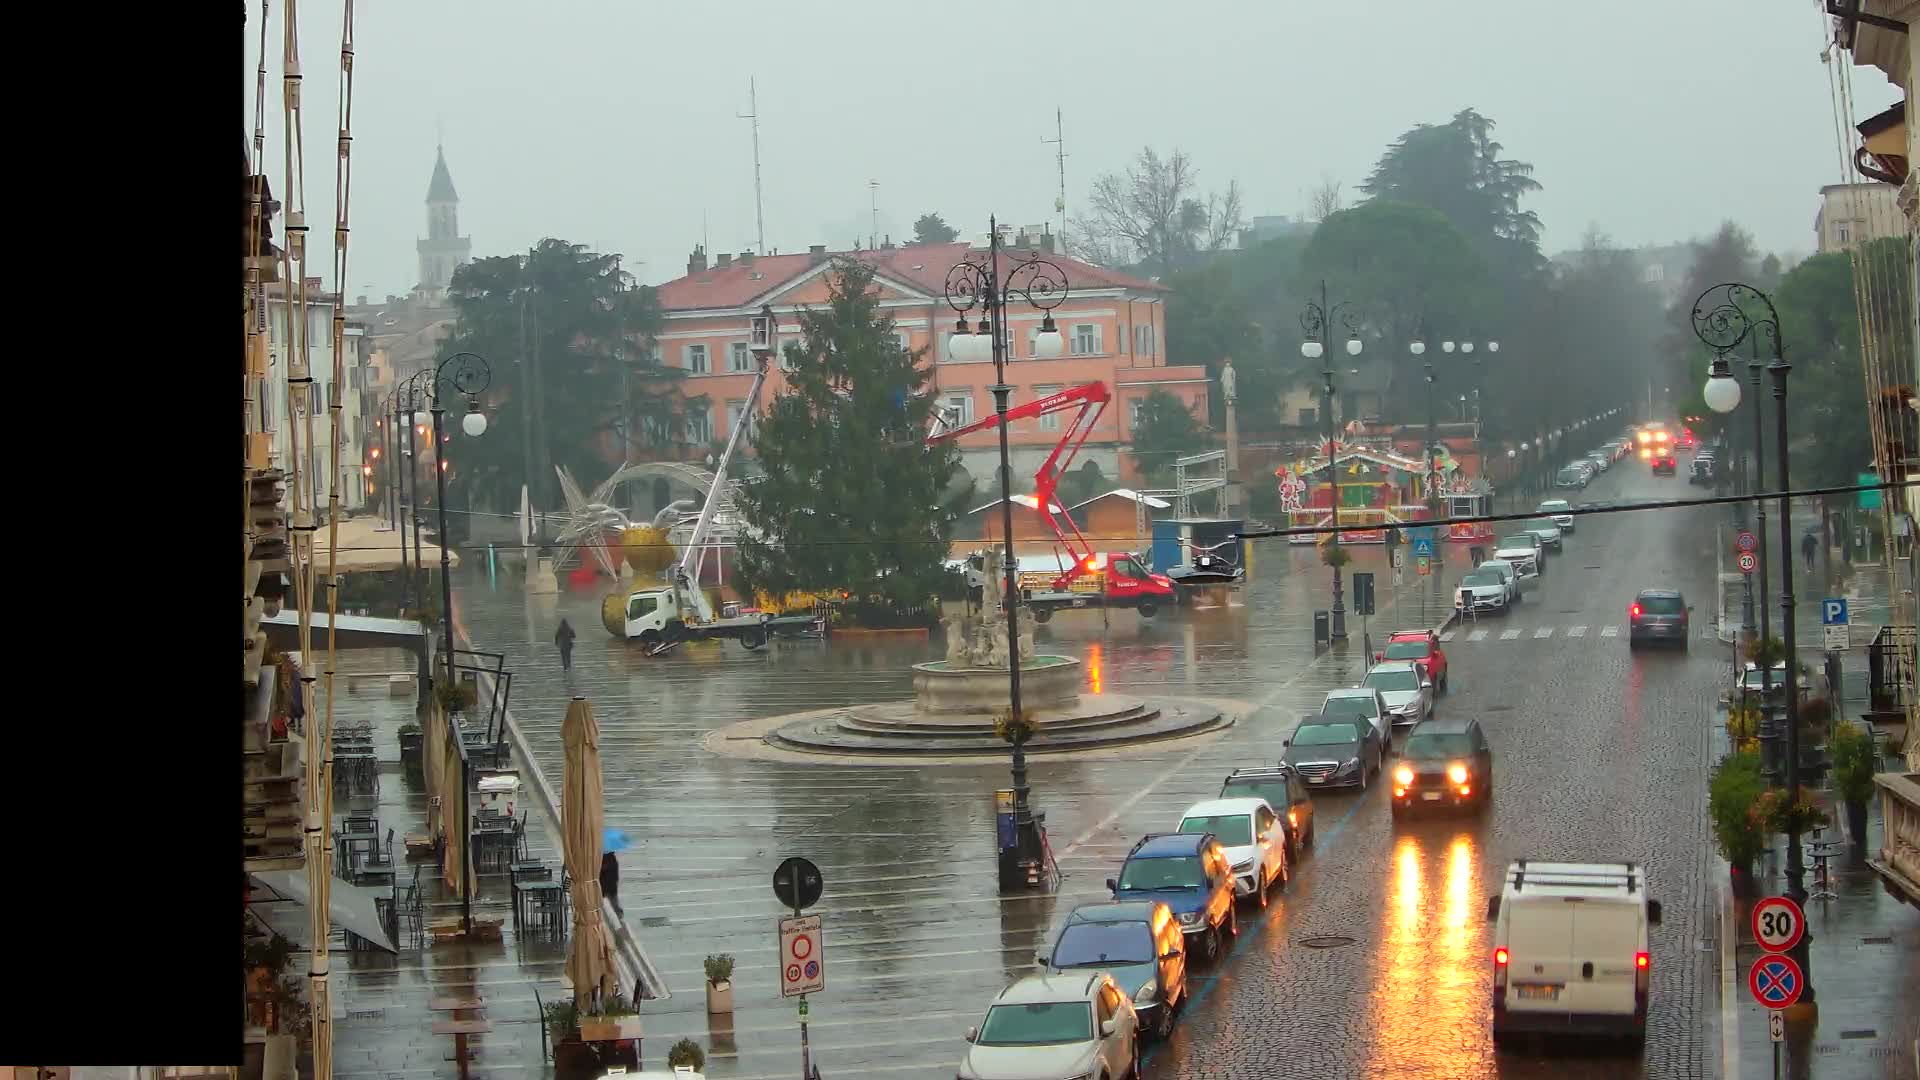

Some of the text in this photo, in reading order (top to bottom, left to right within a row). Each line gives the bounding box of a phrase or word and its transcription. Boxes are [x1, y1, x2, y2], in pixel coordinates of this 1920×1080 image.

[1742, 557, 1753, 567] 20
[1827, 602, 1842, 621] P
[1762, 911, 1791, 938] 30
